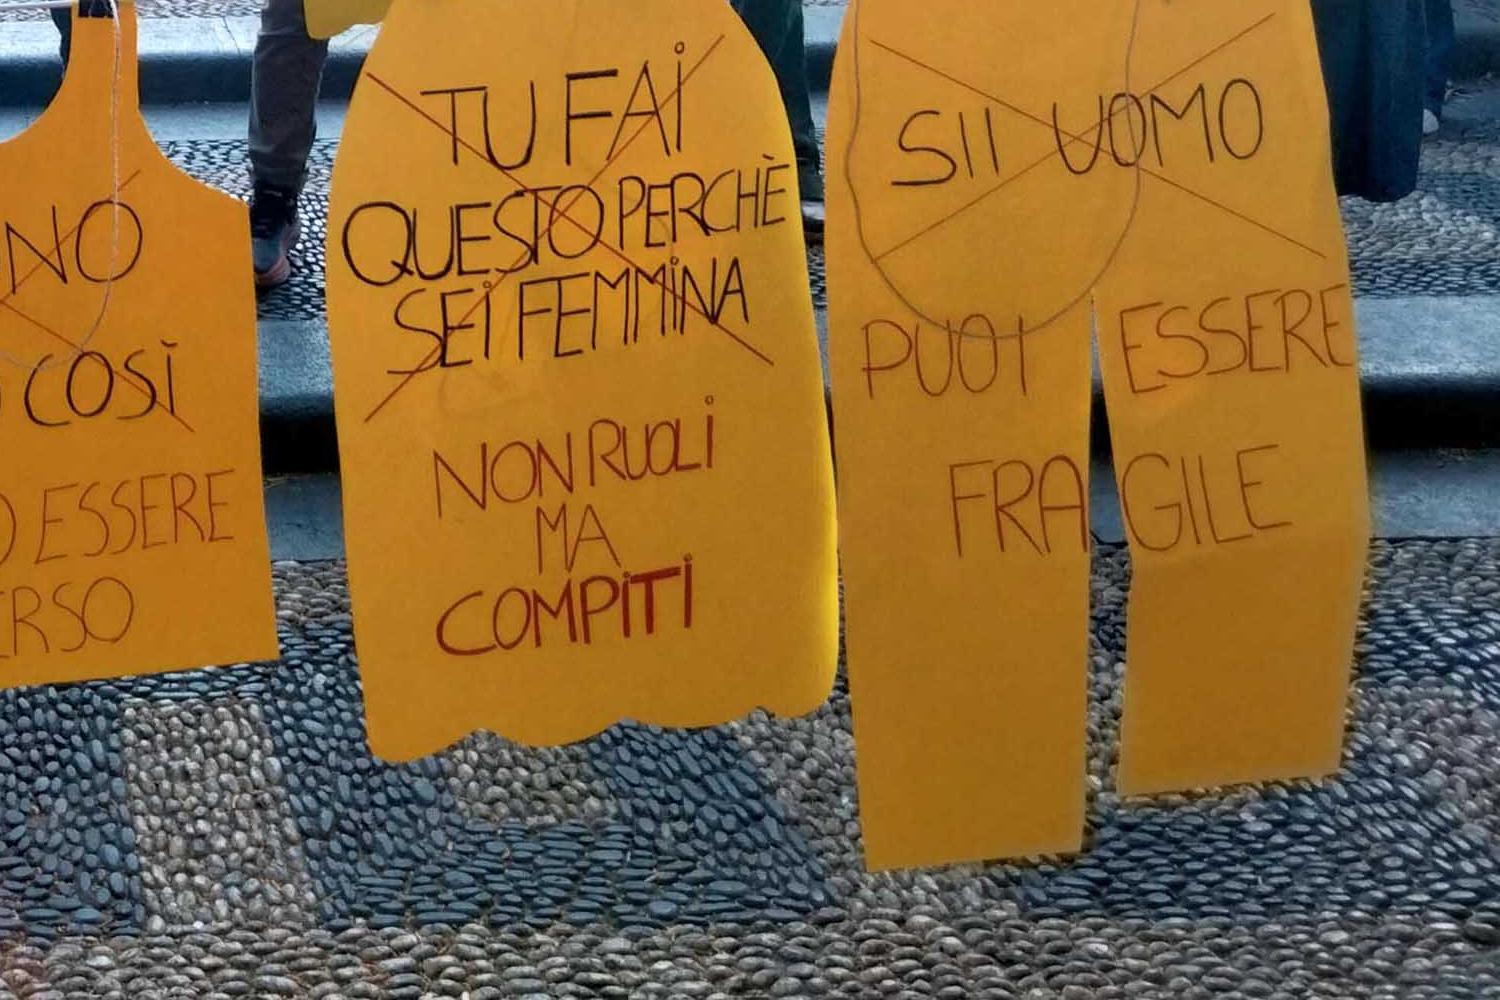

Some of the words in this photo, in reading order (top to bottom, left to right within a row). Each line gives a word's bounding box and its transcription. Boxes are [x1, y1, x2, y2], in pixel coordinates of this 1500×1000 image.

[420, 80, 536, 172] TU
[891, 106, 1000, 187] SII
[1053, 78, 1264, 175] UOMO
[341, 183, 605, 288] QUESTO
[861, 313, 1029, 399] PUOI
[1120, 283, 1355, 394] ESSERE
[35, 469, 236, 565] ESSERE
[432, 432, 575, 519] NON
[534, 503, 622, 576] MA
